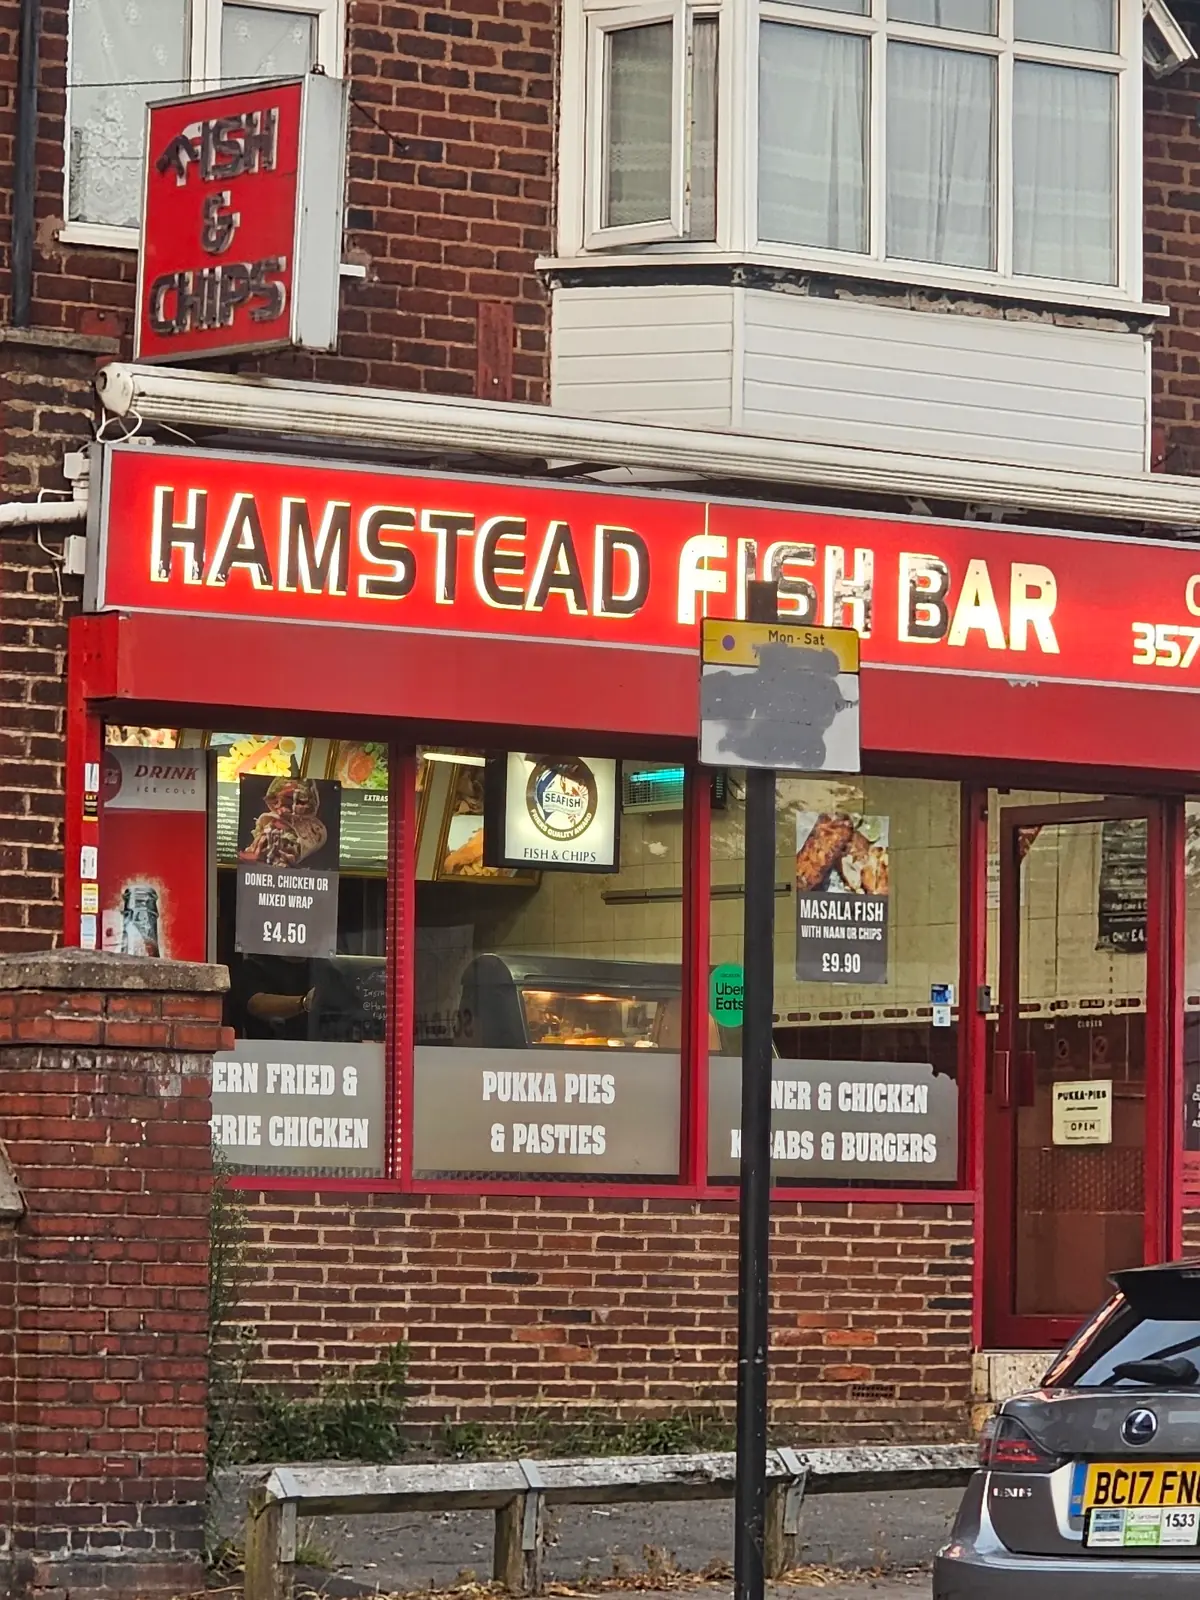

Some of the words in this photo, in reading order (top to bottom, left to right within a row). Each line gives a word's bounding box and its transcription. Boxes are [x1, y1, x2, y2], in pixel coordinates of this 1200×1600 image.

[155, 107, 279, 187] FISH
[201, 190, 241, 255] &
[149, 255, 287, 336] CHIPS
[149, 484, 652, 620] HAMSTEAD
[676, 533, 875, 640] FISH
[897, 550, 1061, 655] BAR
[768, 630, 794, 643] Mon
[803, 632, 825, 645] Sat
[134, 764, 199, 780] DRINK
[165, 787, 196, 795] COLD
[363, 794, 388, 803] EXTRAS
[544, 793, 581, 808] SEAFISH
[530, 808, 548, 832] FRIERS
[547, 828, 574, 839] QUALITY
[573, 812, 593, 835] AWARD
[523, 847, 549, 860] FISH
[551, 849, 560, 861] &
[562, 850, 597, 862] CHIPS
[244, 872, 275, 888] DONER,
[277, 874, 315, 891] CHICKEN
[316, 877, 329, 891] OR
[258, 892, 286, 908] MIXED
[288, 895, 314, 910] WRAP
[800, 899, 852, 920] MASALA
[854, 901, 884, 922] FISH
[262, 920, 307, 945] £4.50
[801, 925, 822, 939] WITH
[823, 926, 845, 939] NAAN
[846, 926, 857, 940] OR
[858, 927, 882, 941] CHIPS
[822, 952, 861, 974] £9.90
[715, 982, 744, 996] Uber
[715, 997, 744, 1011] Eats
[265, 1062, 336, 1096] FRIED
[342, 1065, 358, 1097] &
[482, 1070, 558, 1103] PUKKA
[564, 1072, 616, 1105] PIES
[770, 1080, 812, 1111] NER
[817, 1082, 832, 1111] &
[838, 1081, 929, 1114] CHICKEN
[268, 1115, 369, 1149] CHICKEN
[1070, 1122, 1096, 1131] OPEN
[490, 1122, 505, 1153] &
[512, 1122, 607, 1156] PASTIES
[730, 1128, 815, 1161] KABS
[820, 1131, 835, 1161] &
[841, 1131, 938, 1164] BURGERS
[1093, 1468, 1155, 1505] BC17
[1158, 1470, 1200, 1504] FN
[1165, 1513, 1195, 1528] 1533
